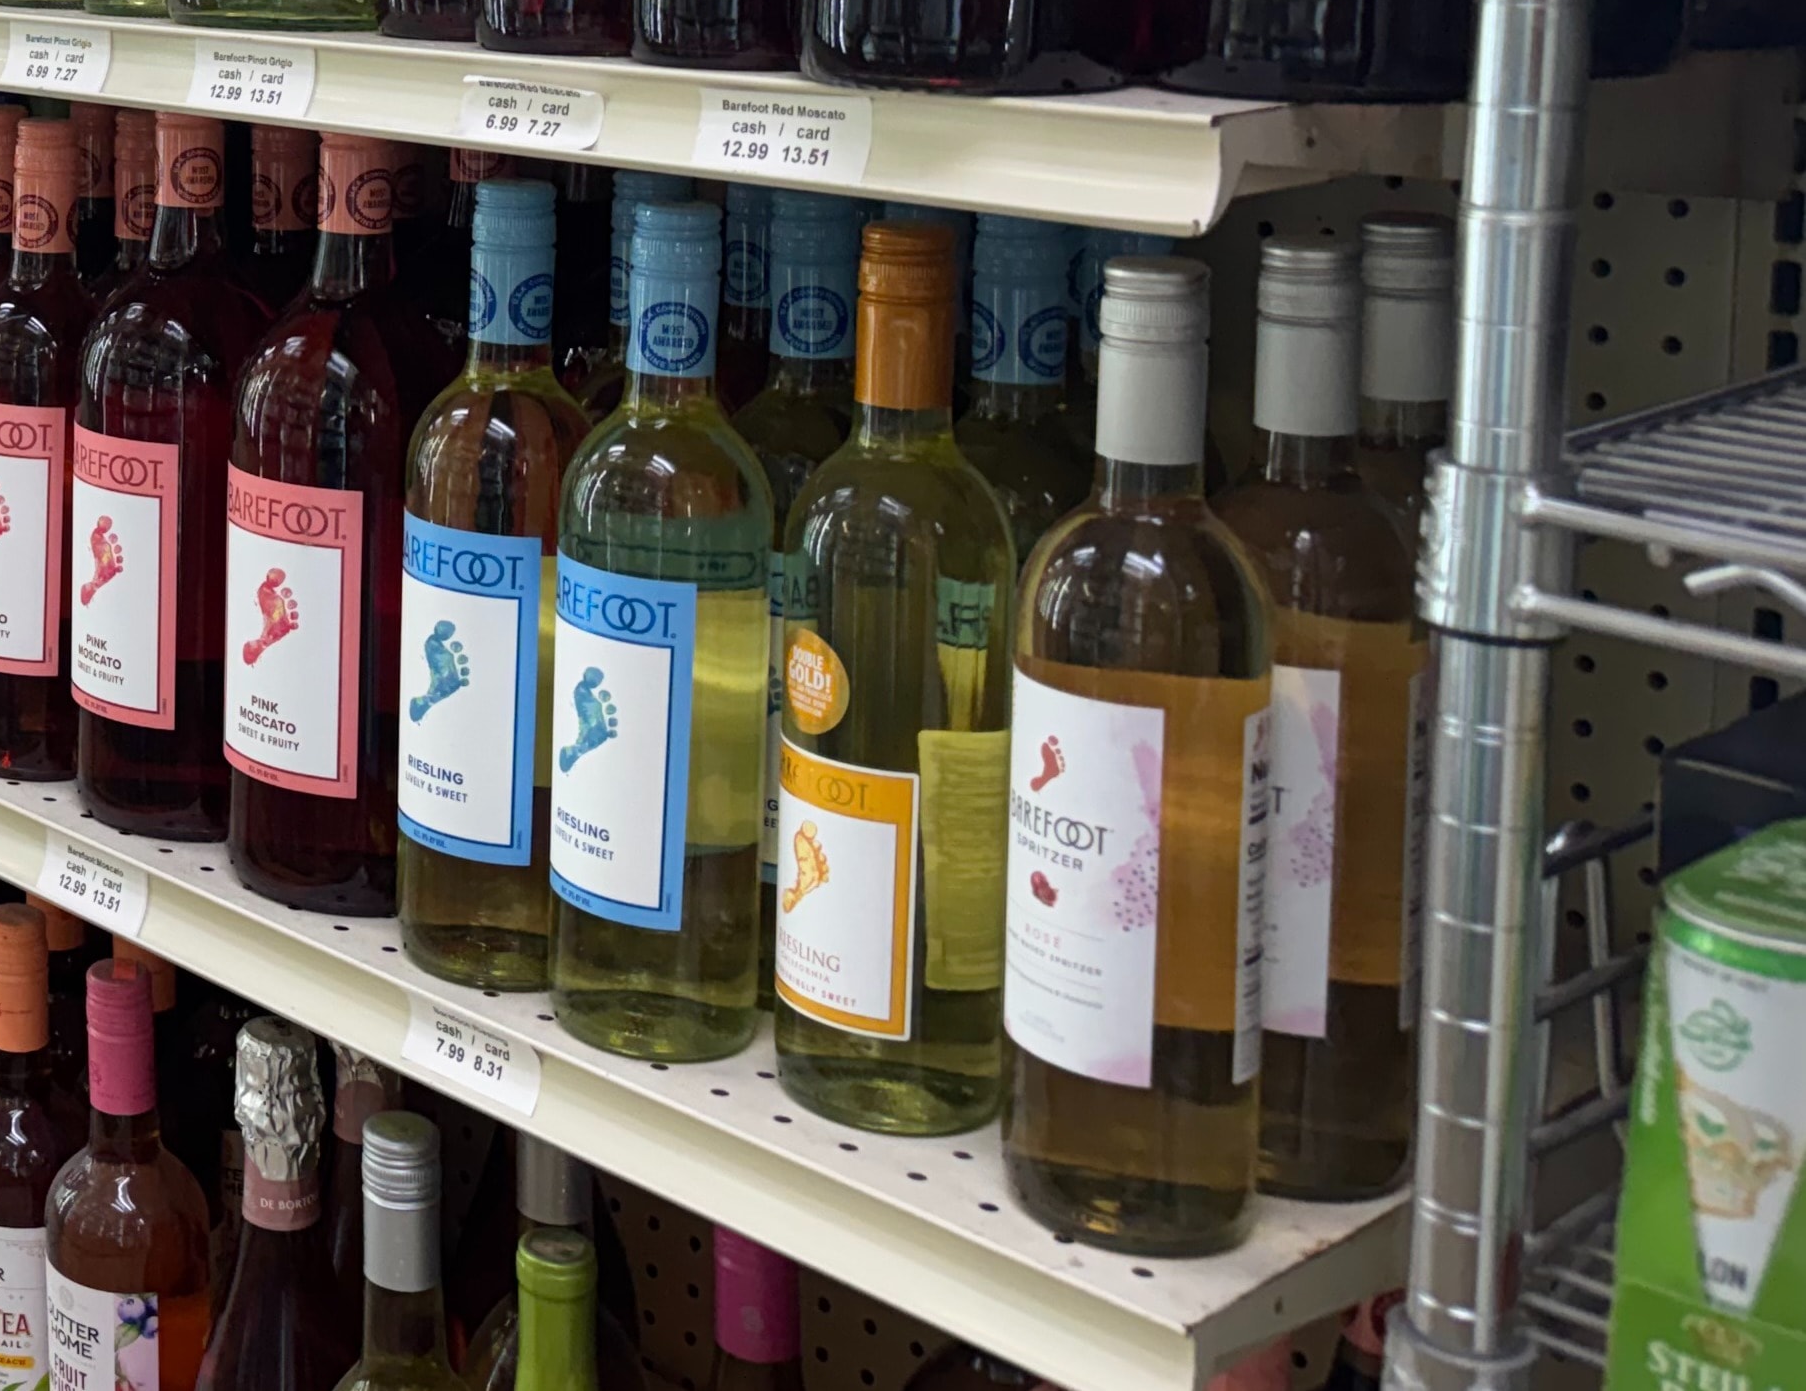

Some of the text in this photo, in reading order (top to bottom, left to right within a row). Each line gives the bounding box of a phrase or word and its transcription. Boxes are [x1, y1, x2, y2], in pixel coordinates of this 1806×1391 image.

[26, 33, 53, 44] Barefoot
[54, 36, 70, 45] Pinot
[29, 48, 84, 64] cash card
[268, 57, 293, 69] Grigio
[26, 64, 77, 81] 6.99 7.27
[218, 68, 284, 85] cash card
[209, 85, 282, 105] 12.99 13.51
[488, 94, 570, 116] cash card
[722, 99, 846, 121] Barefoot Red Moscato
[485, 114, 561, 137] 6.99 7.27
[732, 120, 830, 142] cash card
[722, 140, 830, 167] 12.99 13.51
[662, 324, 684, 334] MOST
[653, 336, 694, 348] AWARDED
[228, 484, 346, 540] BAREFOOT
[86, 634, 107, 651] PINK
[78, 644, 122, 670] MOSCATO
[99, 671, 124, 686] FRUITY
[789, 660, 832, 693] GOLD!
[251, 695, 278, 714] PINK
[239, 706, 296, 734] MOSCATO
[238, 723, 300, 751] SWEET FRUITY
[408, 754, 463, 786] RIESLING
[405, 772, 468, 804] LIVELY SWEET
[557, 807, 610, 842] RIESLING
[582, 843, 614, 861] SWEET
[1017, 832, 1083, 872] SPRITZER
[66, 860, 122, 893] cash card
[59, 874, 120, 912] 12.99 13.51
[778, 926, 840, 972] RIESLING
[436, 1020, 462, 1040] cash
[485, 1042, 510, 1061] card
[436, 1038, 503, 1080] 7.99 8.31
[260, 1198, 274, 1210] DE
[52, 1325, 93, 1359] HOME
[54, 1353, 87, 1389] FRUIT
